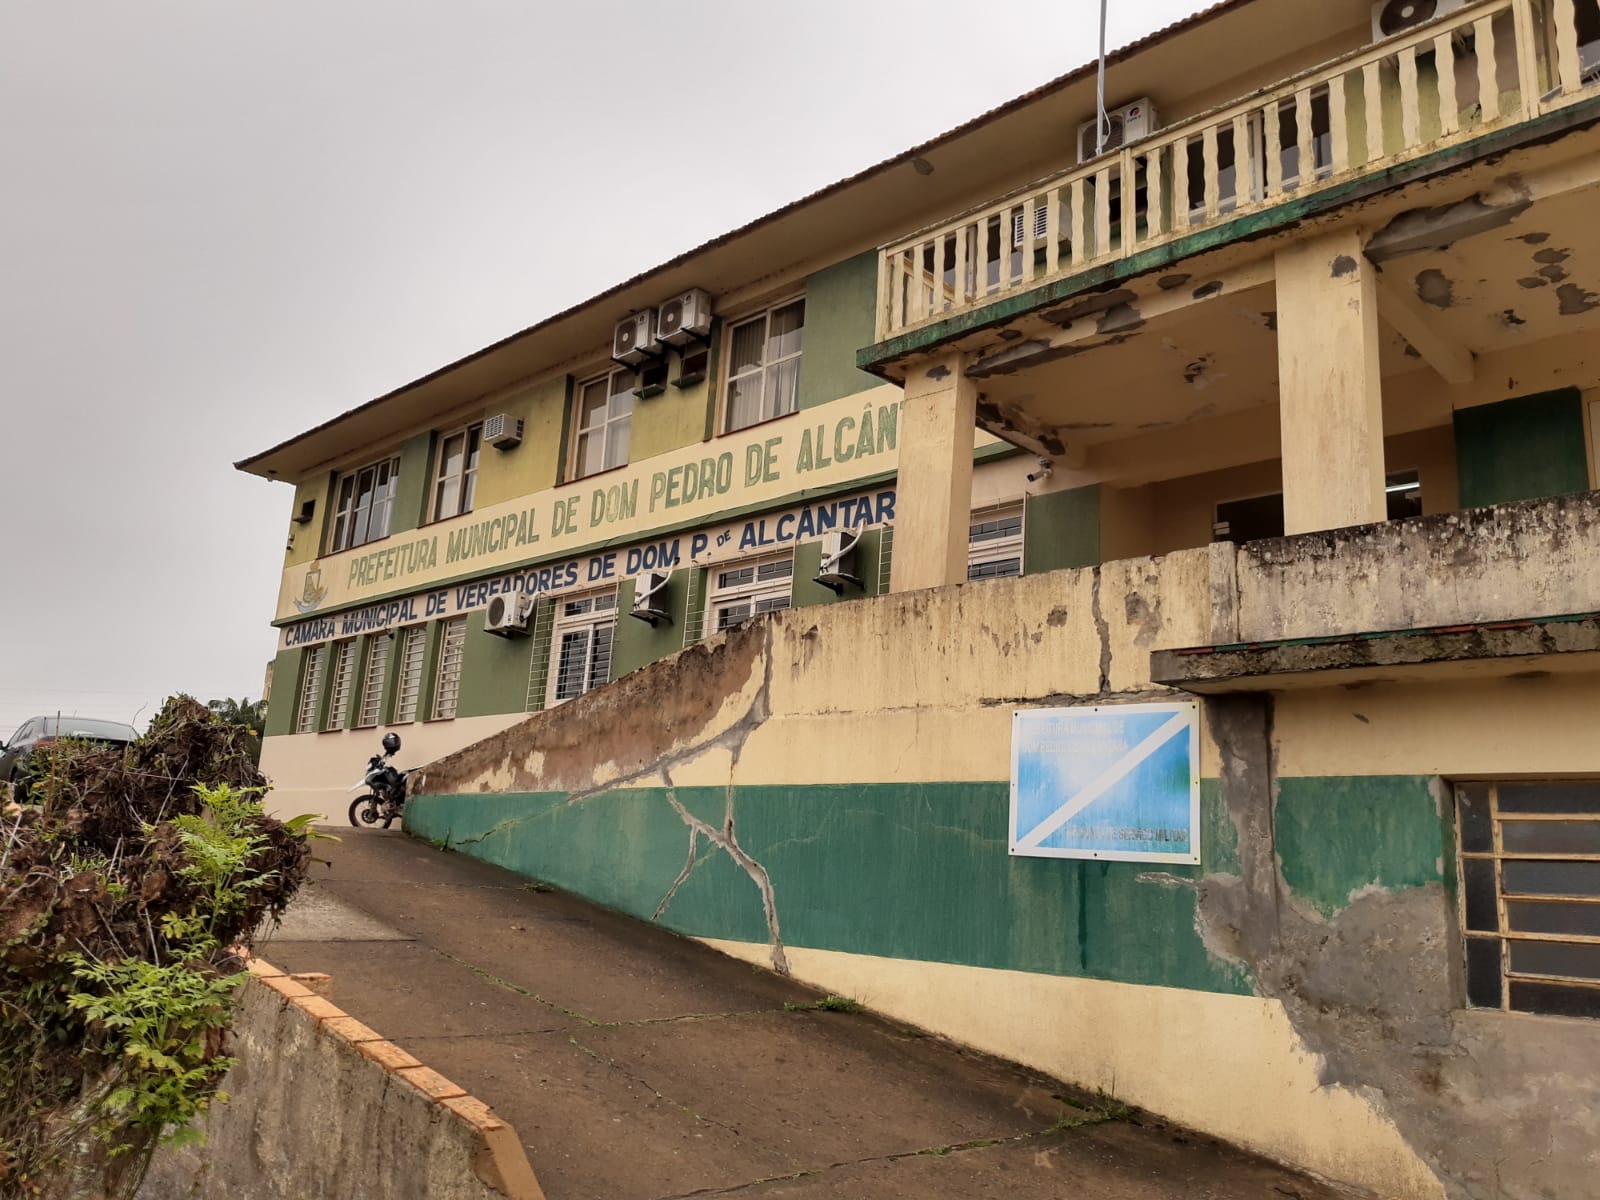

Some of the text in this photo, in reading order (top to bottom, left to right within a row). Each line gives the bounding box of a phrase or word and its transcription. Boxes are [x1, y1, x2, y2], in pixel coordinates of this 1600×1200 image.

[348, 402, 904, 589] PREFEITURA MUNICIPAL DE DOM PEDRO DE ALCÂN
[341, 598, 418, 636] MUNICIPAL
[425, 590, 447, 617] DE
[456, 561, 579, 610] VEREADORES
[587, 553, 616, 582] DE
[626, 538, 681, 575] DOM
[716, 529, 732, 548] DE
